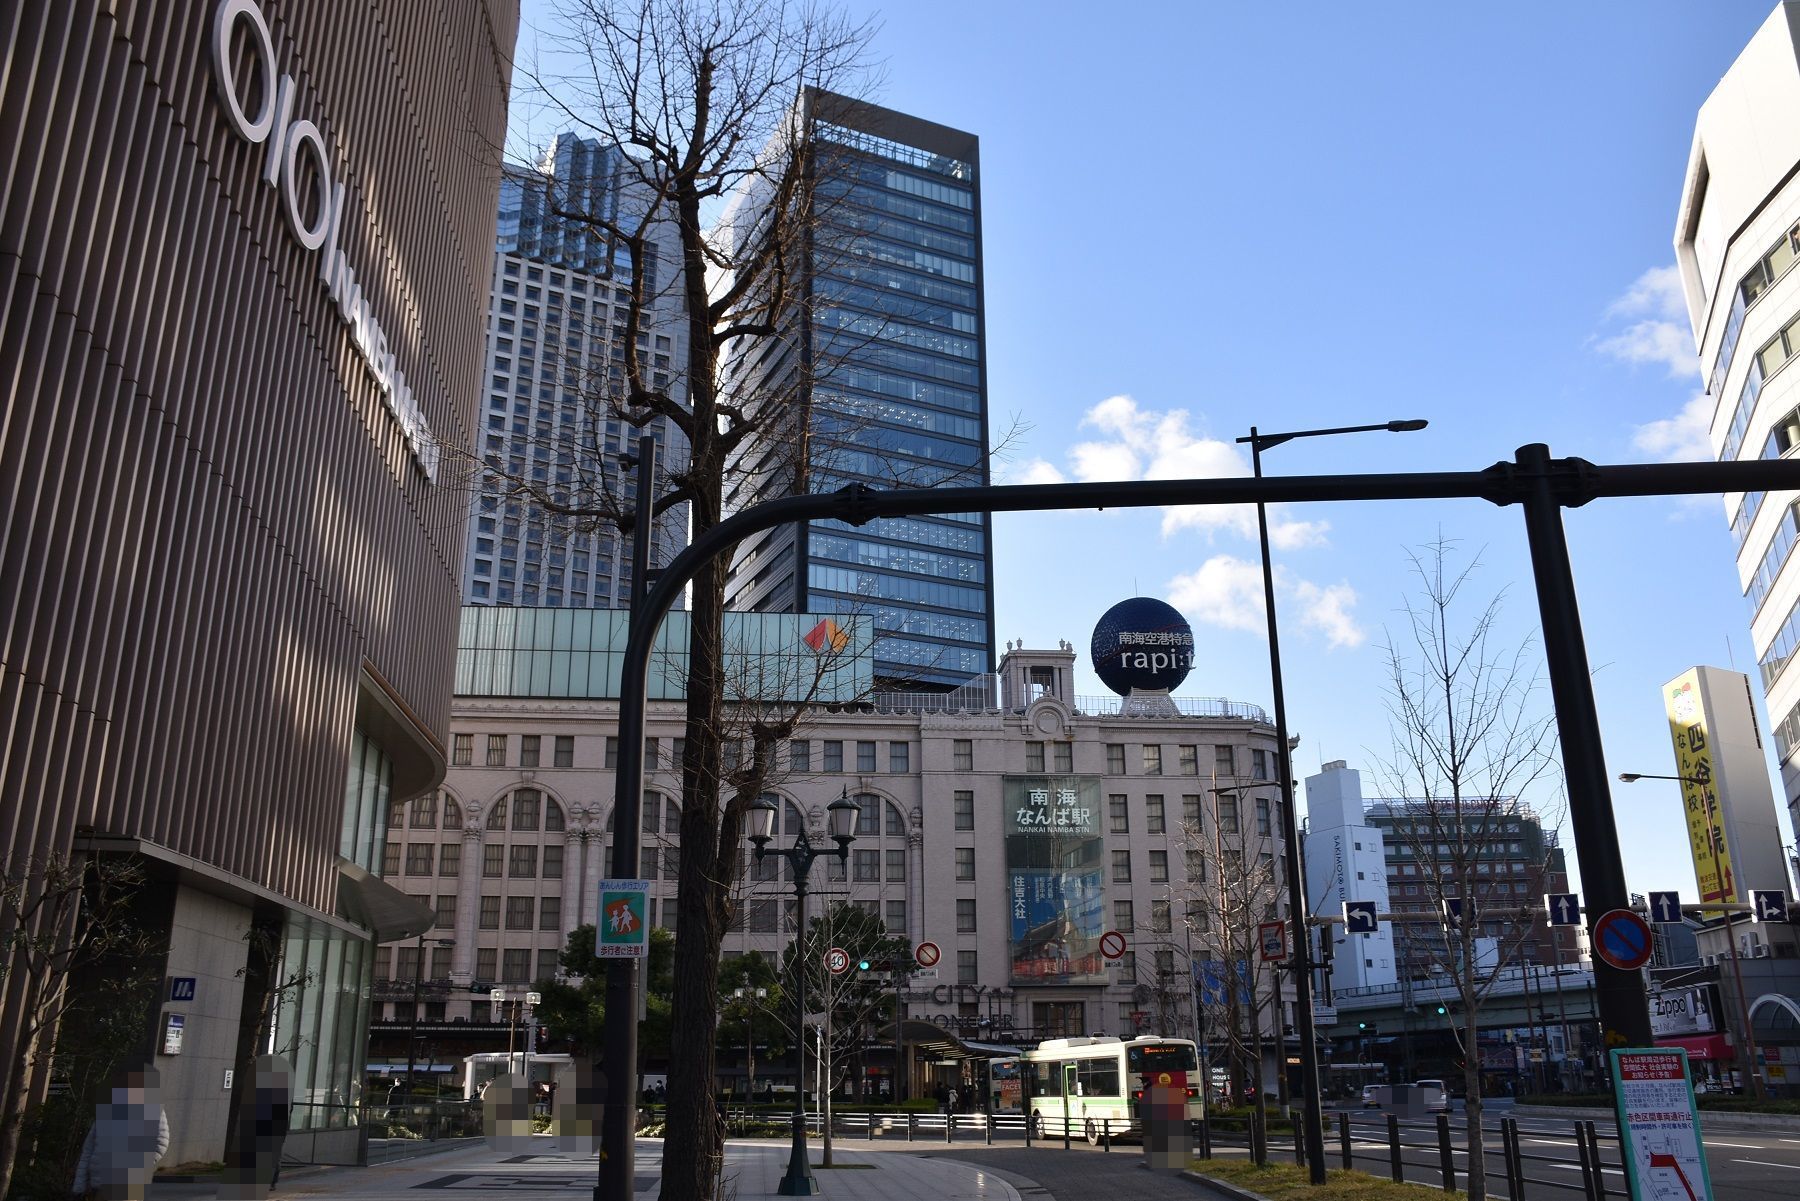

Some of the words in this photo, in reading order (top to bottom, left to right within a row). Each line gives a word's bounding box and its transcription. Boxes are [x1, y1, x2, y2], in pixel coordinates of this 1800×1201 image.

[1119, 631, 1194, 646] 南海空港特急
[1016, 807, 1090, 825] なんば駅
[1014, 875, 1026, 920] 住吉大社
[832, 955, 844, 967] 40
[933, 984, 987, 1006] CITY
